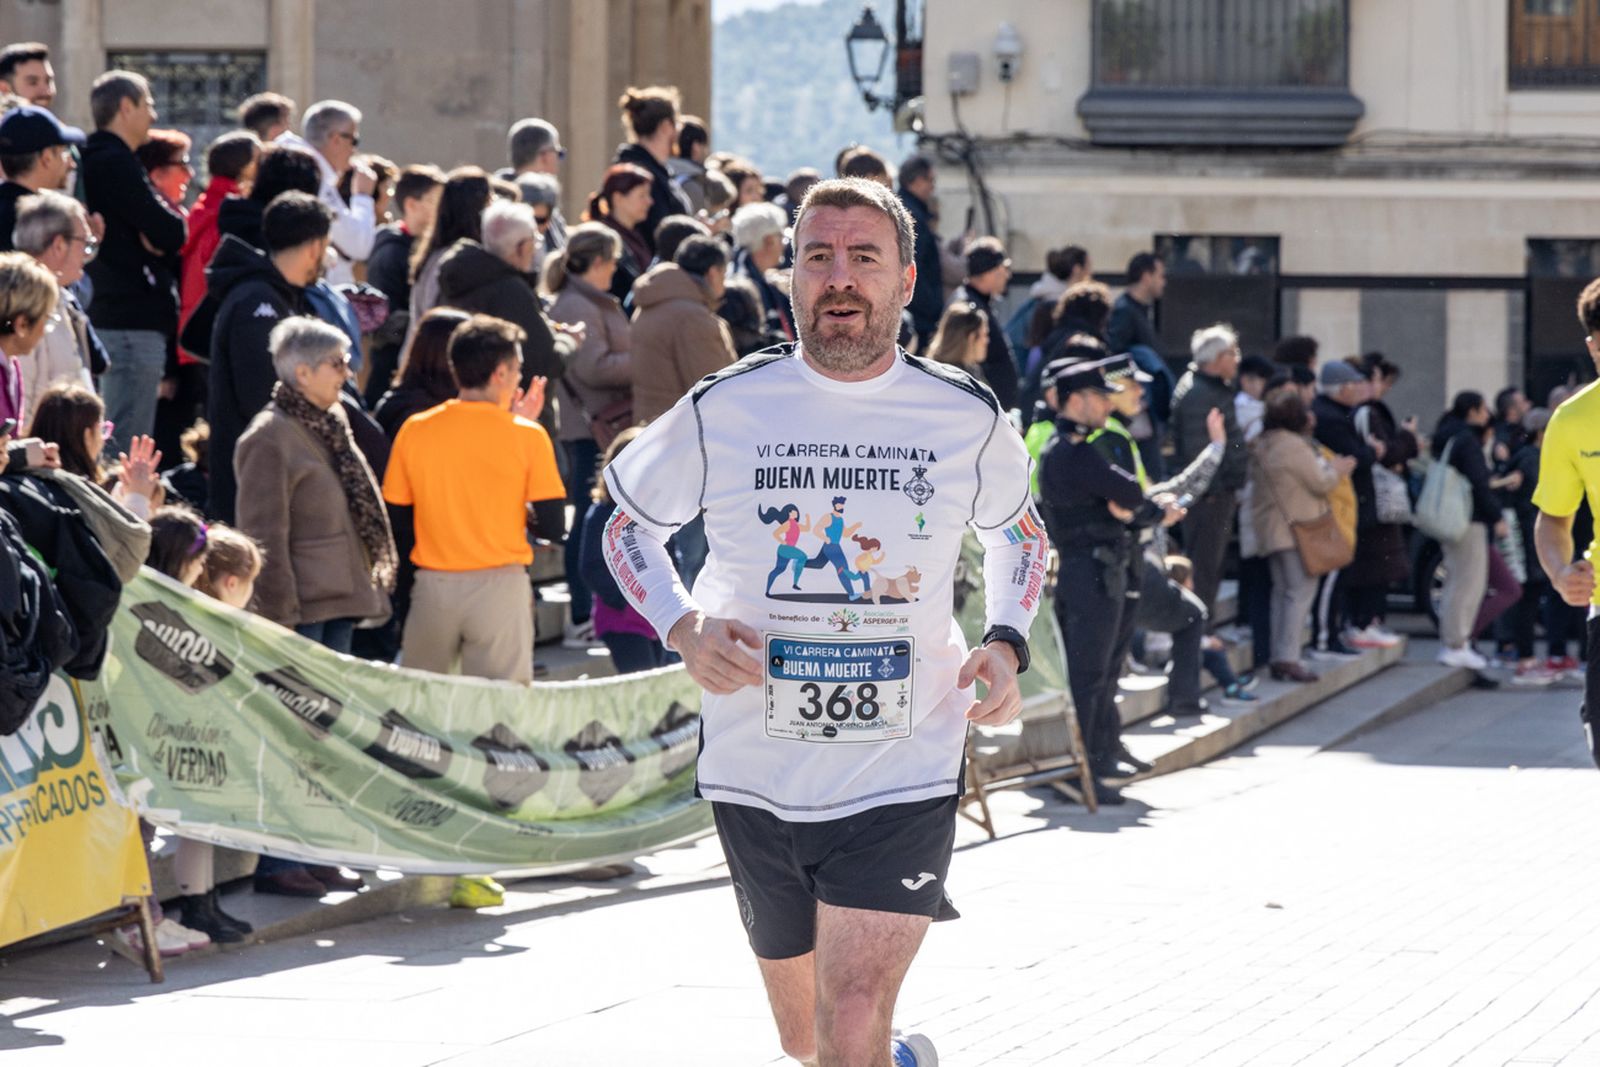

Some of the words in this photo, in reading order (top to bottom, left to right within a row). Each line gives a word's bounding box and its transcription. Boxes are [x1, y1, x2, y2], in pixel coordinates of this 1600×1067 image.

[756, 444, 770, 458] VI
[775, 443, 850, 458] CARRERA
[855, 444, 937, 463] CAMINATA
[754, 466, 816, 490] BUENA
[823, 467, 900, 491] MUERTE
[777, 614, 808, 623] beneficio
[783, 645, 793, 655] VI
[795, 645, 841, 658] CARRERA
[843, 645, 895, 658] CAMINATA
[783, 660, 821, 677] BUENA
[824, 662, 872, 678] MUERTE
[798, 682, 880, 722] 368
[806, 720, 834, 728] ANTONIO
[167, 745, 228, 788] VERDAD
